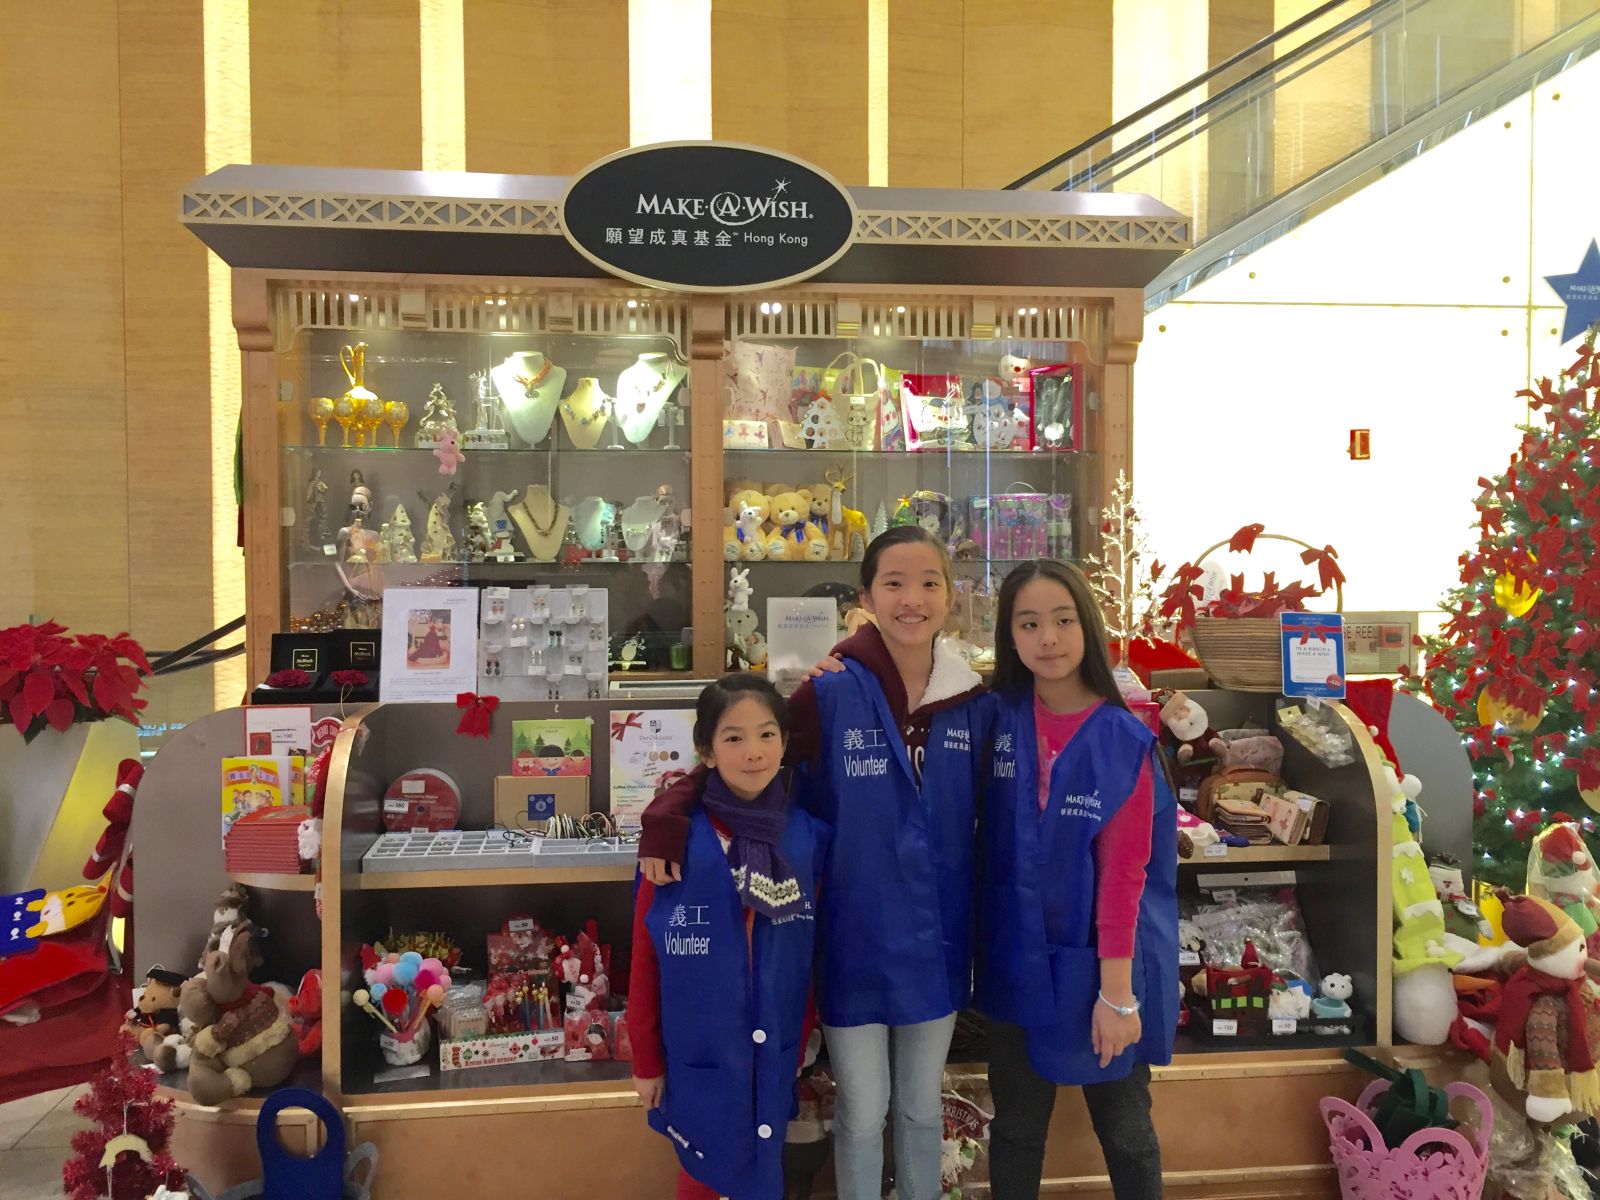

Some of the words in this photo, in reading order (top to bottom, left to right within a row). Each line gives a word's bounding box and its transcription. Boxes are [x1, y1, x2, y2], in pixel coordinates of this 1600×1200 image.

[605, 226, 738, 247] 願望成真基金
[743, 231, 774, 246] Hong
[779, 232, 808, 247] Kong
[843, 727, 886, 751] 義工
[994, 733, 1014, 752] 義
[843, 754, 887, 778] Volunteer
[668, 903, 710, 927] 義工
[664, 931, 711, 956] Volunteer
[941, 1103, 980, 1131] CHRISTMAS
